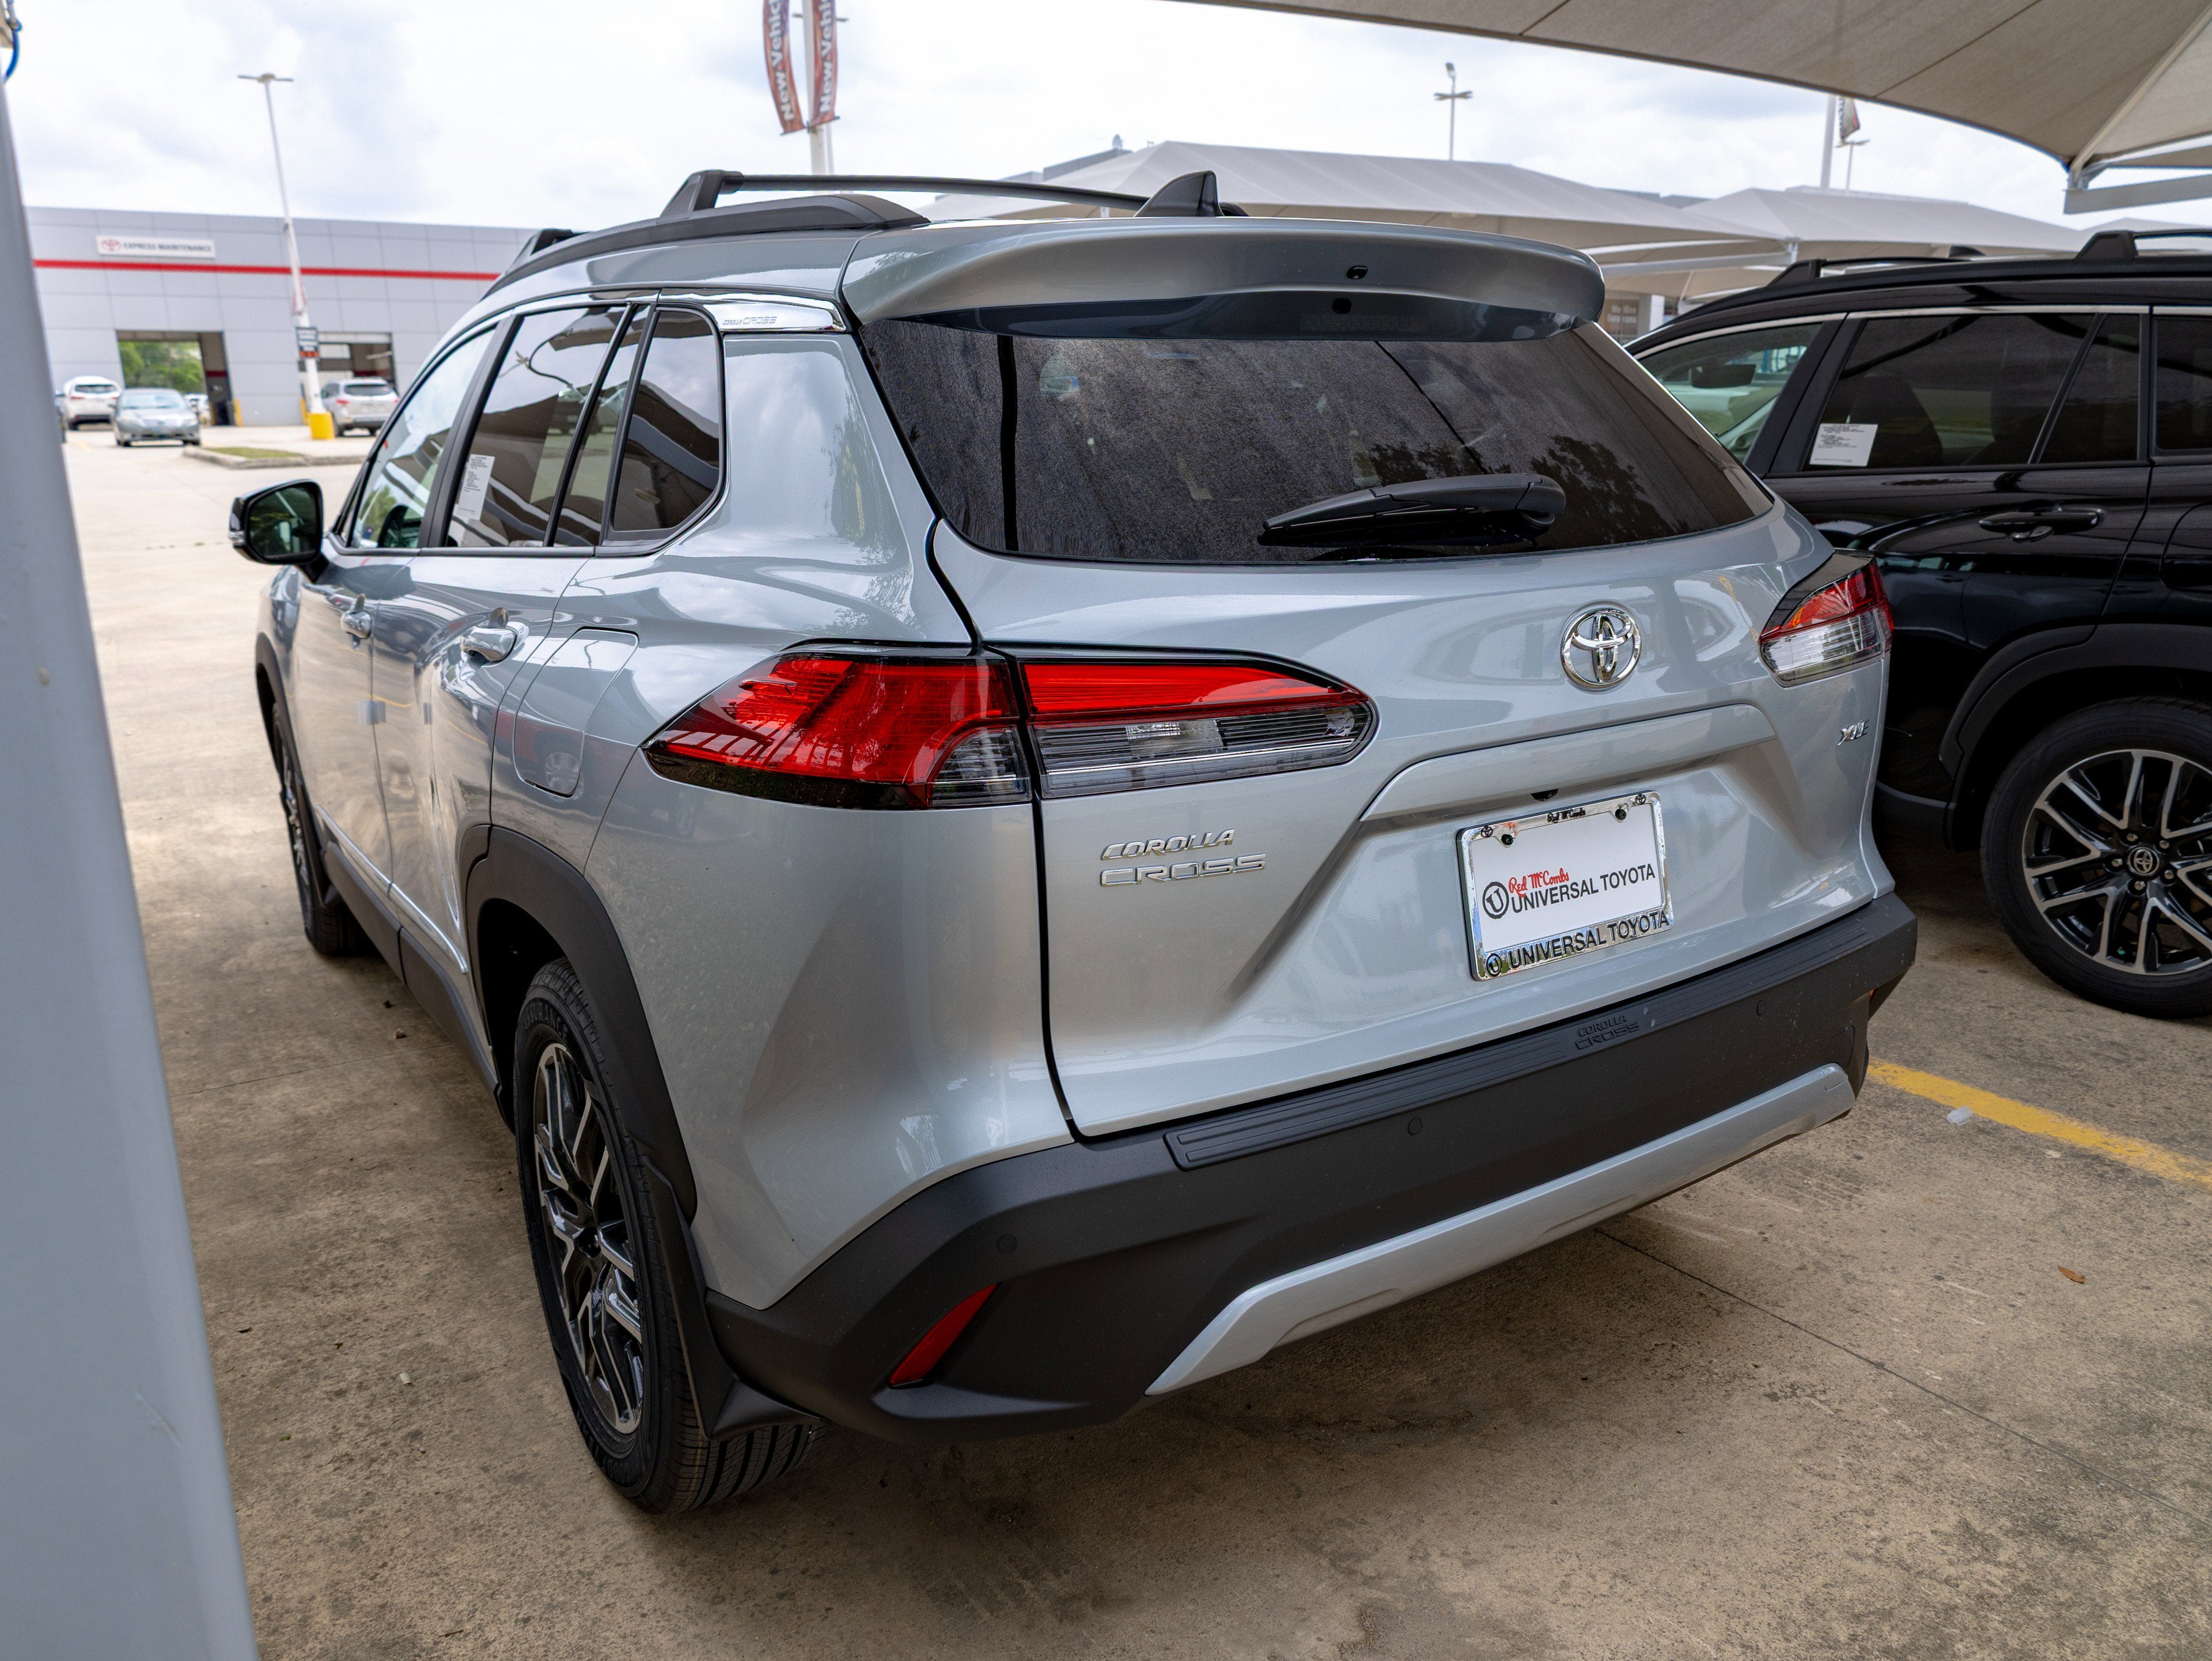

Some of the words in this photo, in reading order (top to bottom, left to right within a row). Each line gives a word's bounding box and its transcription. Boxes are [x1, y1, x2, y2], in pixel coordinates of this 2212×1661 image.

[818, 0, 833, 58] Vehi
[775, 70, 795, 121] New
[820, 59, 833, 113] New
[123, 242, 156, 250] EXPRESS
[743, 316, 777, 325] CROSS
[1100, 828, 1235, 861] COROLLA
[1100, 853, 1266, 887] CROSS
[1508, 876, 1528, 898] Red
[1527, 868, 1570, 889] McCombs
[1511, 878, 1599, 913] UNIVERSAL
[1600, 864, 1656, 891] TOYOTA
[1508, 927, 1607, 969] UNIVERSAL
[1606, 910, 1671, 939] TOYOTA
[1575, 1021, 1640, 1050] CROSS
[1578, 1015, 1627, 1037] COROLLA
